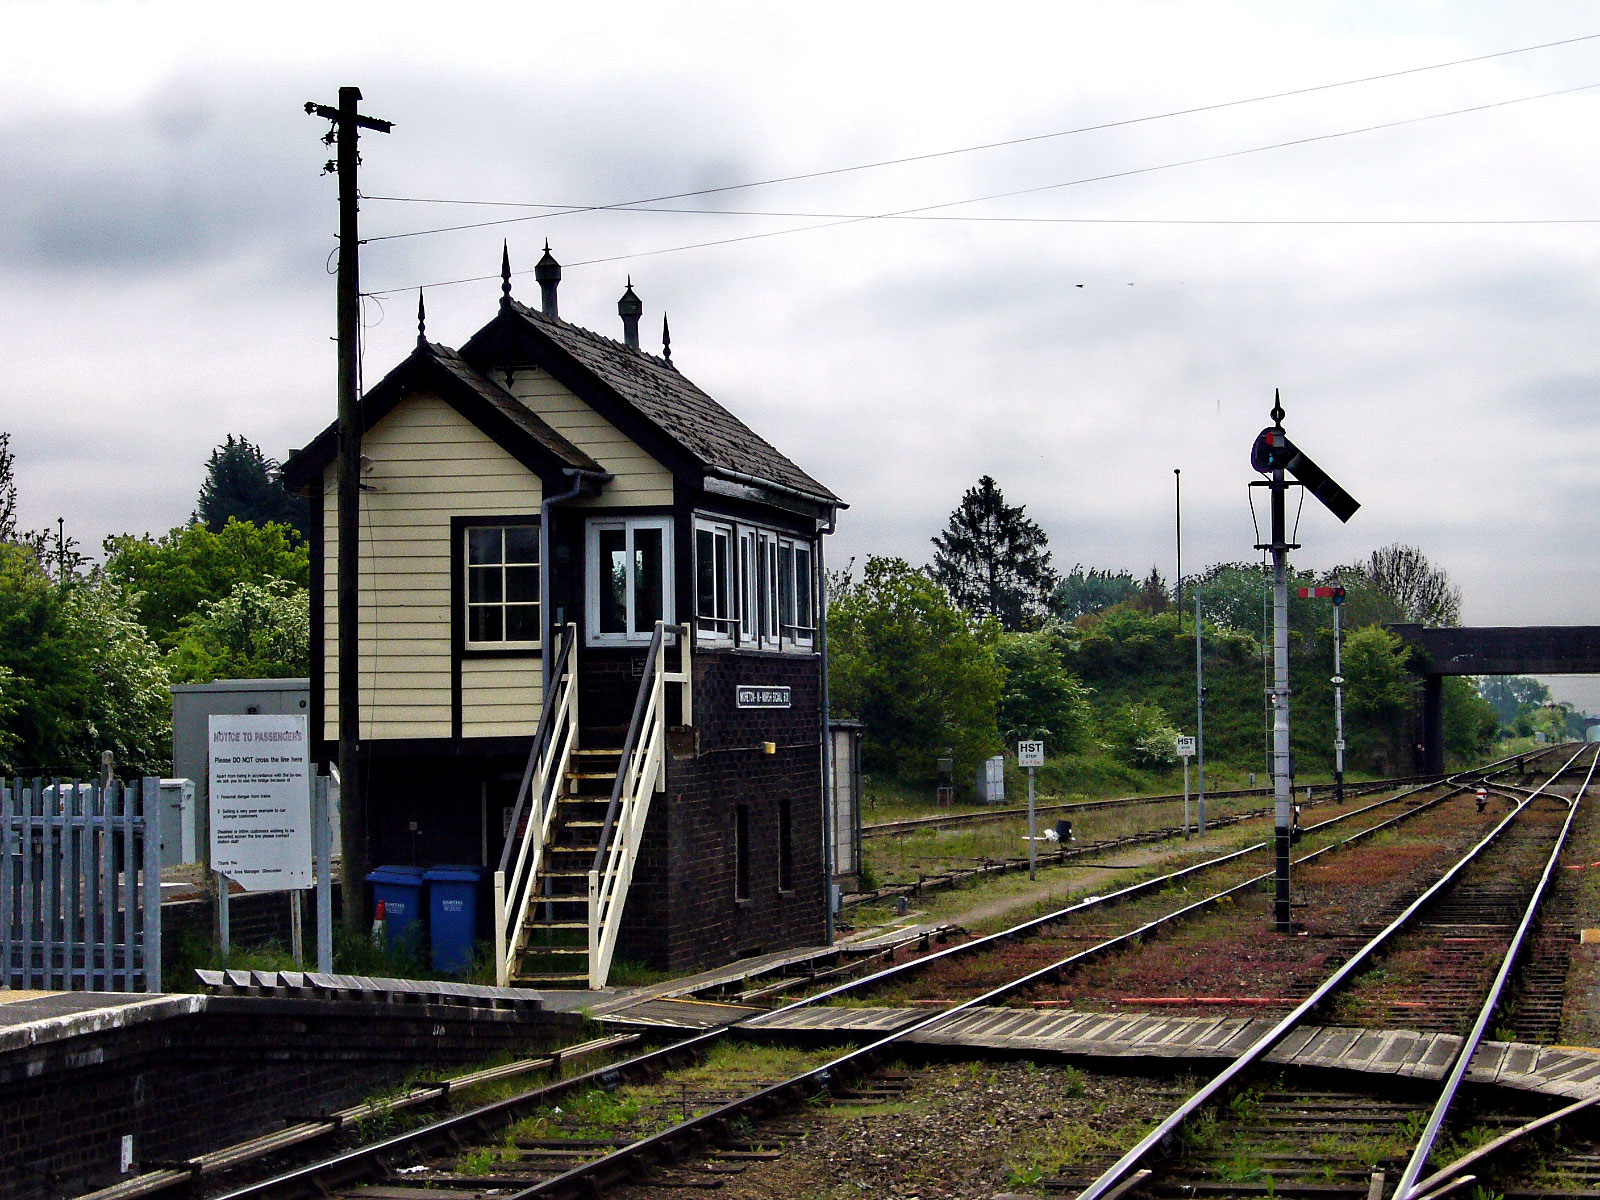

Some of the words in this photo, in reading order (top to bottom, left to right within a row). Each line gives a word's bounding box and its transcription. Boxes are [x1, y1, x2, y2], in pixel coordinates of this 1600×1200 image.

[213, 732, 240, 742] NOTICE
[243, 732, 253, 742] TO
[255, 731, 302, 742] PASSENGERS
[1020, 743, 1042, 752] HST
